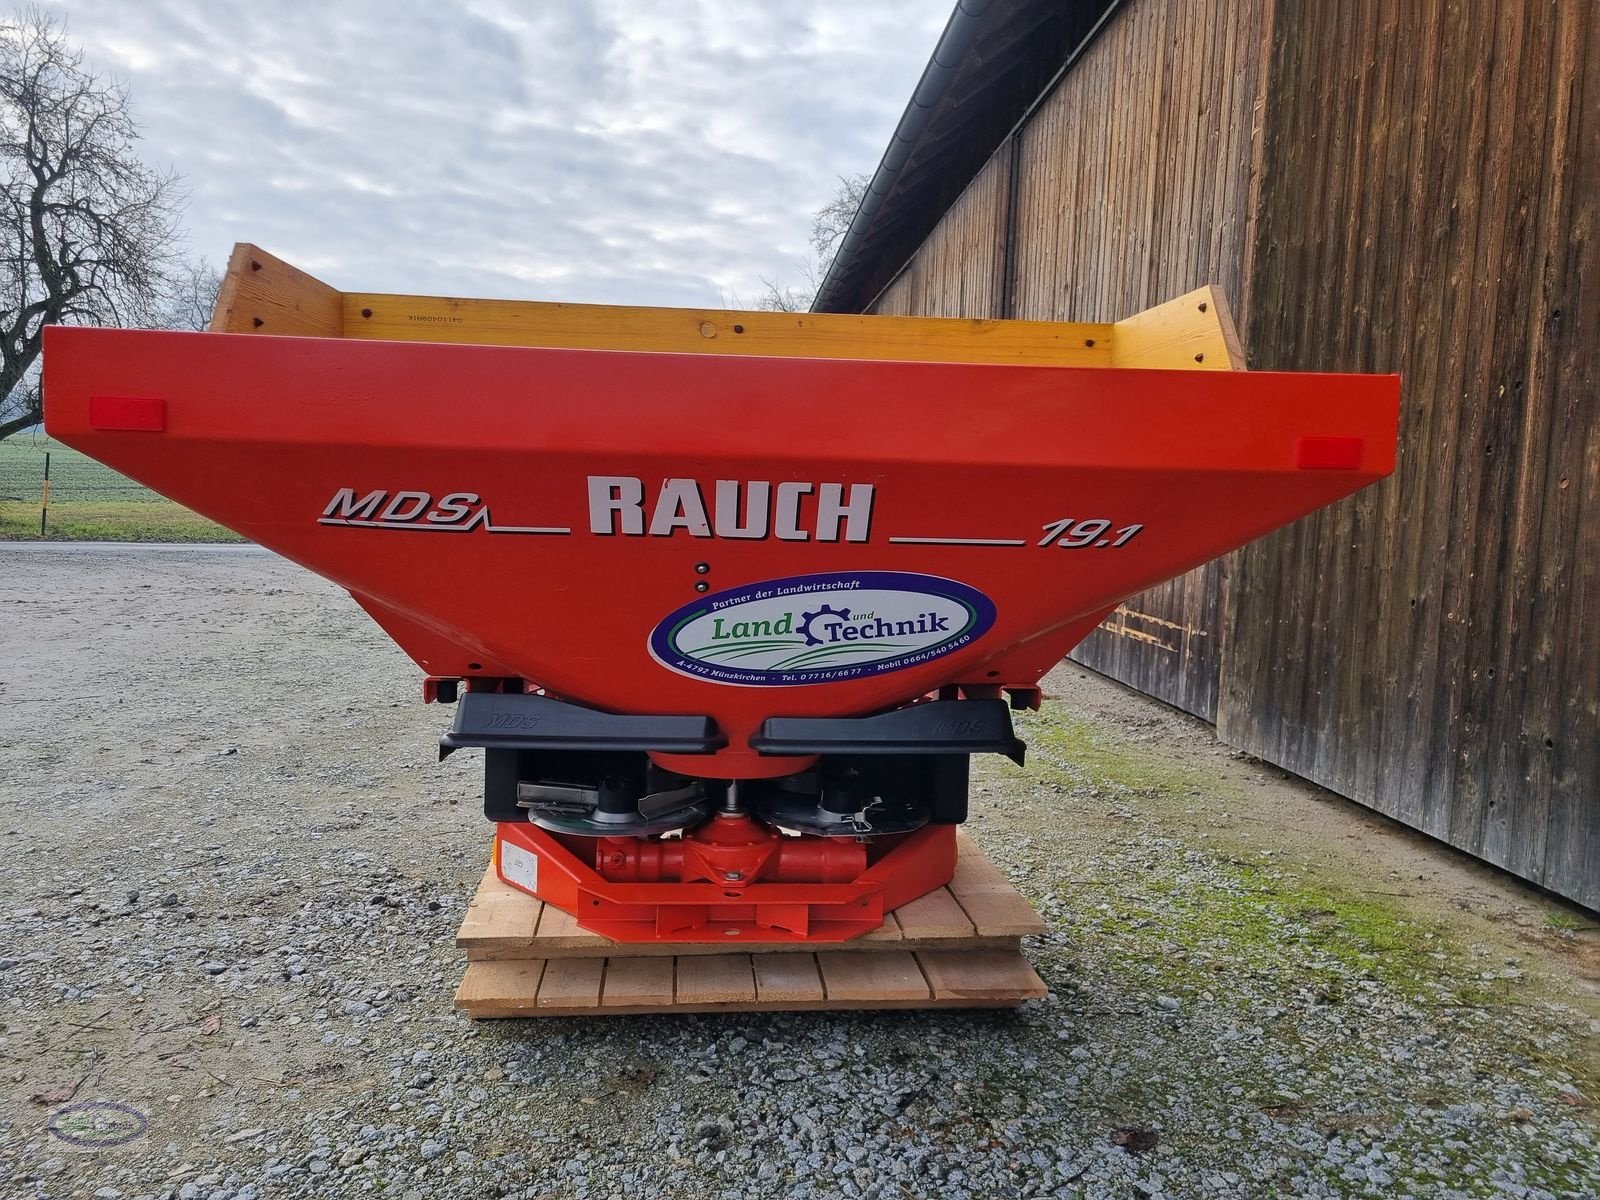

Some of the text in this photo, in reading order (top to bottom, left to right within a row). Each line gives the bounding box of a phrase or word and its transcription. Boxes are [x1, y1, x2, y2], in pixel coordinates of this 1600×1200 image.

[322, 487, 480, 523] MDS
[587, 475, 874, 542] RAUCH
[1036, 518, 1144, 547] 19.1
[712, 580, 861, 610] Partner der Landwirtschaft
[711, 611, 949, 643] Land und Technik
[676, 660, 709, 675] A-4792
[711, 669, 766, 682] Münzkirchen
[877, 660, 901, 671] Mobil
[481, 712, 541, 730] MDS
